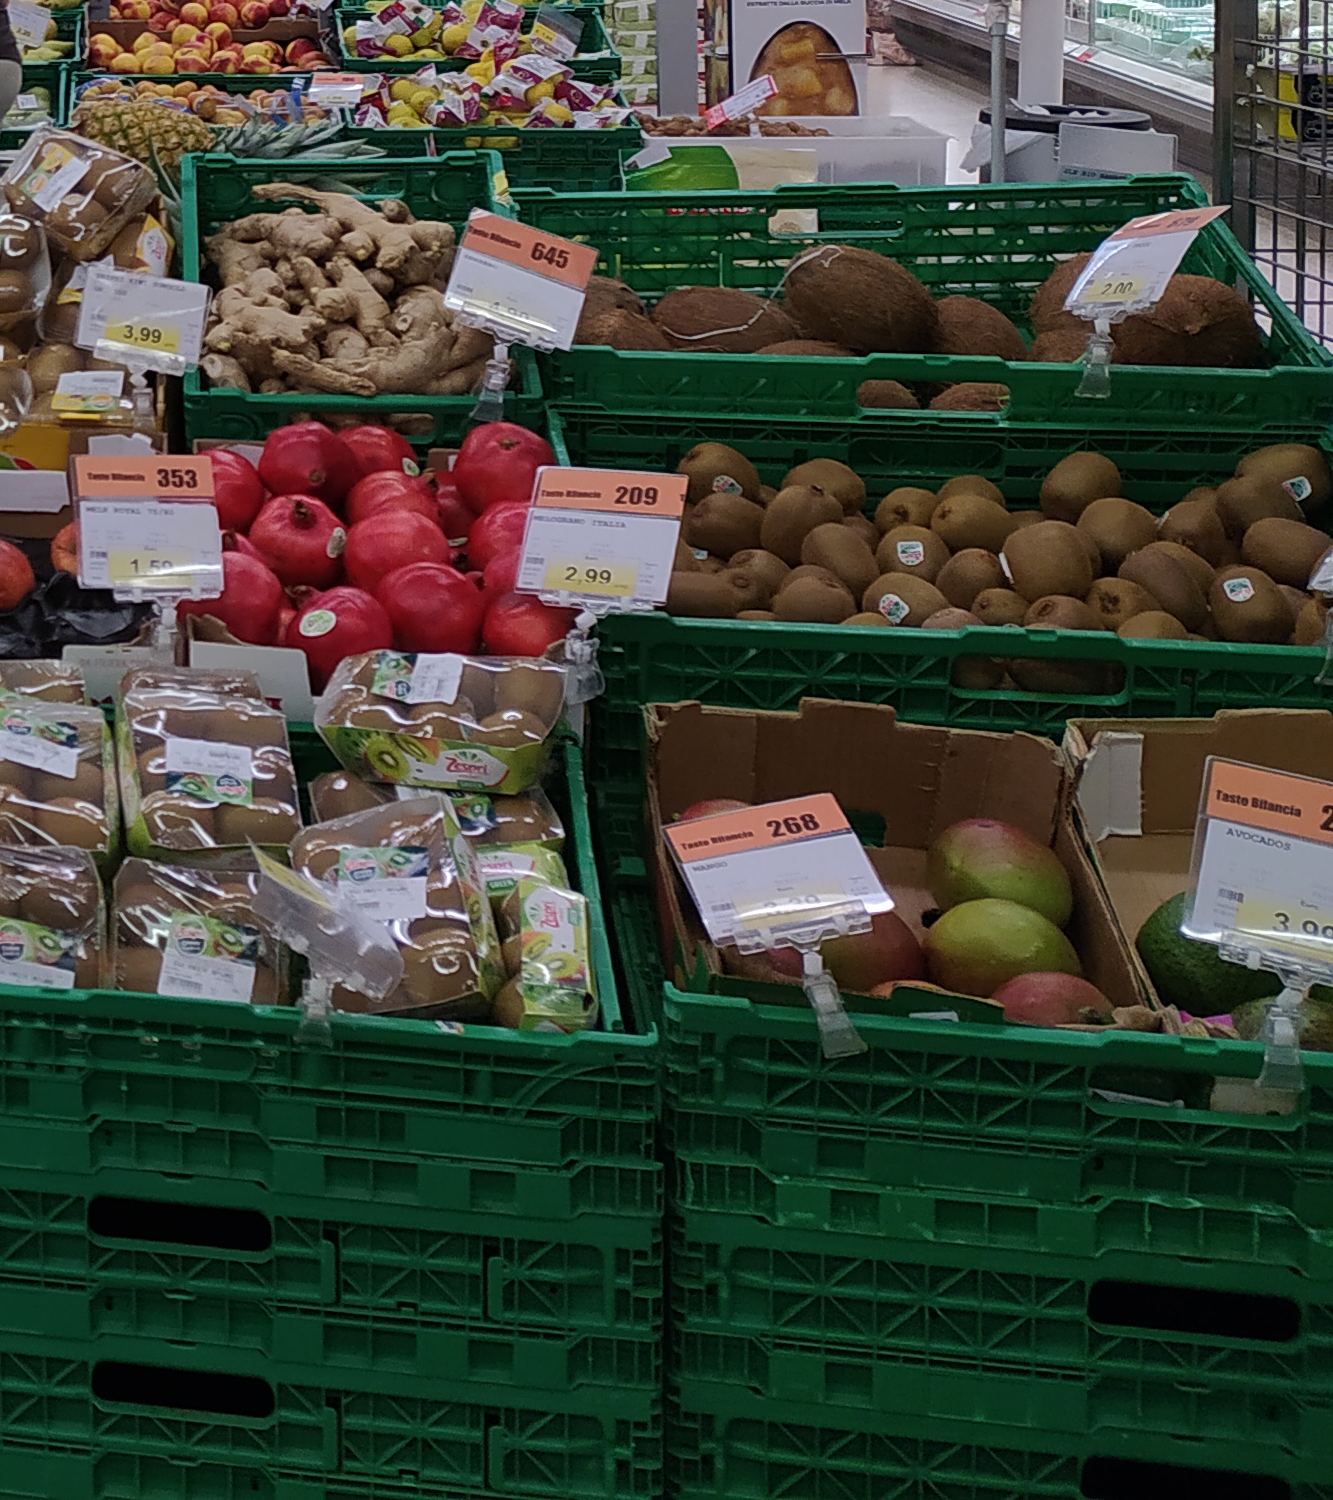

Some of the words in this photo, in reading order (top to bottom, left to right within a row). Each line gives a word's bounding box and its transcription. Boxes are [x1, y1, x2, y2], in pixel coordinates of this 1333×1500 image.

[530, 241, 571, 269] 645
[123, 324, 163, 344] 3,99
[156, 468, 199, 489] 353
[613, 485, 659, 506] 209
[533, 515, 586, 525] MELOGRANO
[591, 519, 627, 529] ITALIA
[564, 566, 612, 586] 2,99
[445, 756, 490, 776] Zespri
[1215, 789, 1250, 807] Tasto
[1250, 797, 1302, 818] Bilancia
[681, 838, 710, 851] Tasto
[710, 830, 754, 846] Bilancia
[766, 812, 820, 839] 268
[1226, 827, 1292, 852] AVOCADOS
[541, 899, 561, 929] Zespri
